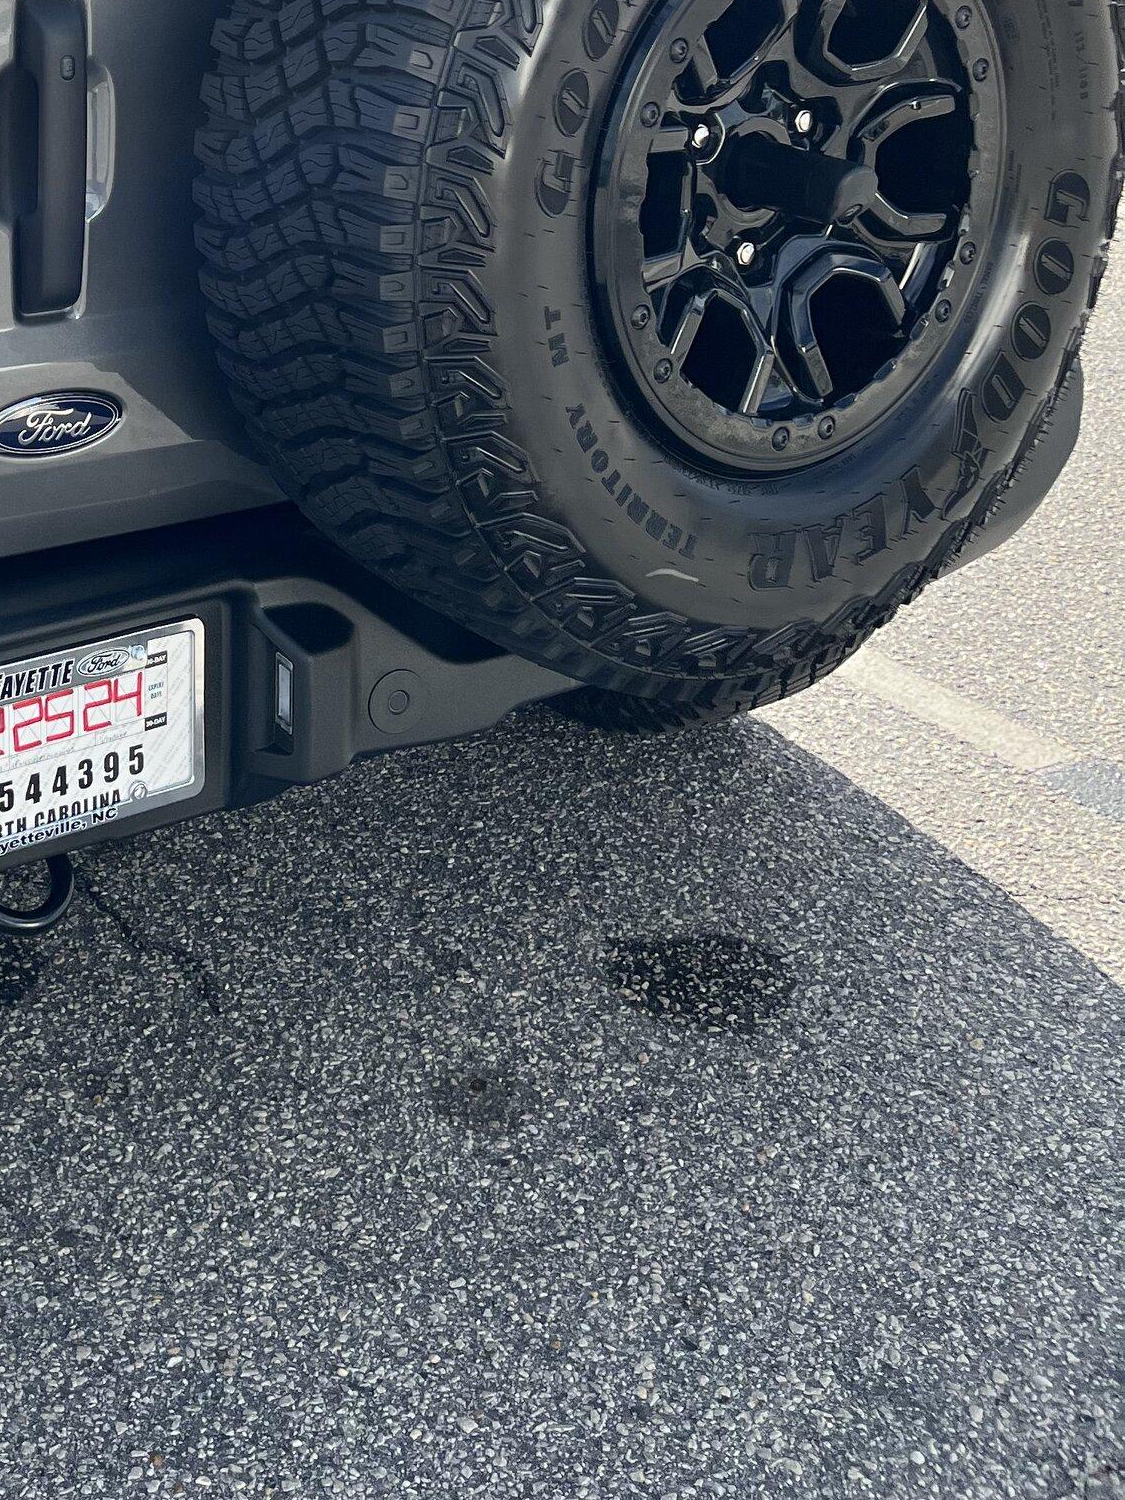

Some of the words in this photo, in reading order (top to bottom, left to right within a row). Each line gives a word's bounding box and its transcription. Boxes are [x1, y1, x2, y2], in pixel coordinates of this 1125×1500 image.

[544, 306, 570, 368] MT
[746, 168, 1090, 591] GOODYEAR
[17, 407, 92, 446] Ford
[565, 403, 697, 560] TERRITORY
[34, 789, 121, 828] CAROLINA
[92, 807, 118, 824] NC
